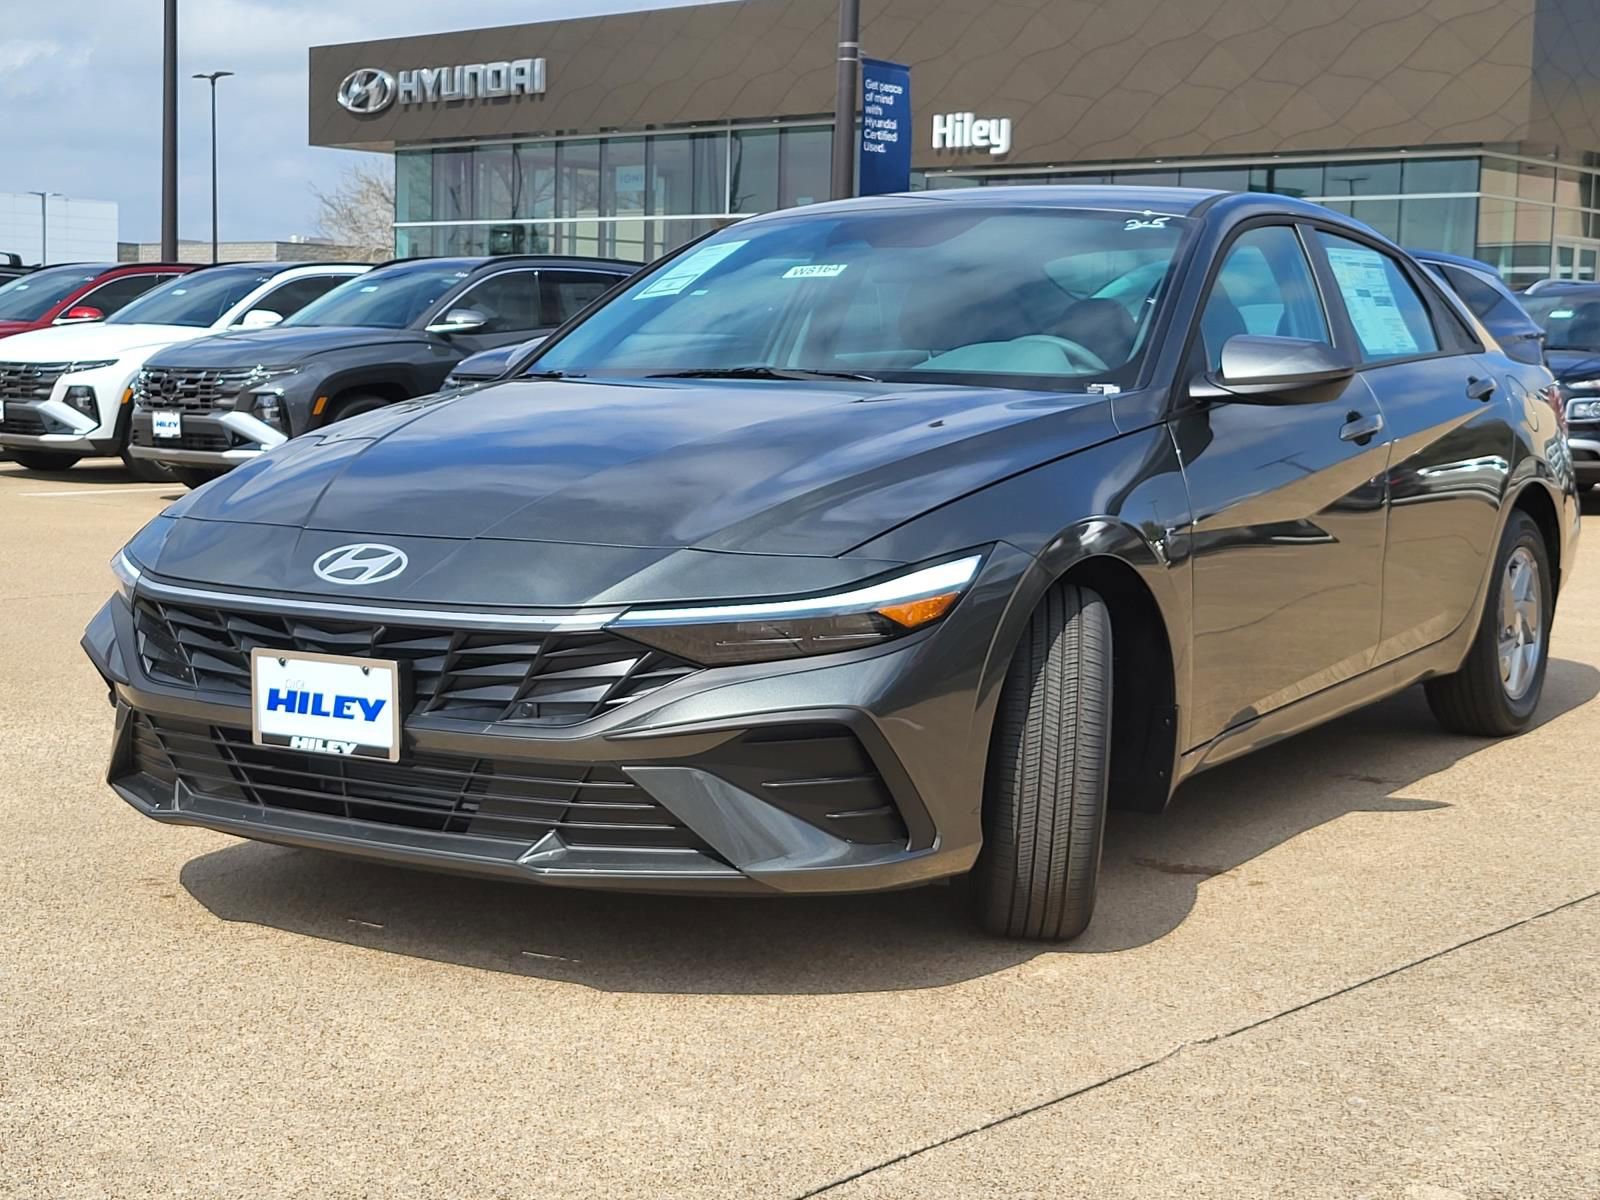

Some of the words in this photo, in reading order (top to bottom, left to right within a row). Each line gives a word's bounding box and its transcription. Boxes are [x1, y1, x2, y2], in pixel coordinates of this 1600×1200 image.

[399, 58, 546, 104] HYUNDAI
[932, 112, 1011, 155] Hiley
[266, 688, 386, 722] HILEY
[290, 736, 358, 755] HILEY
